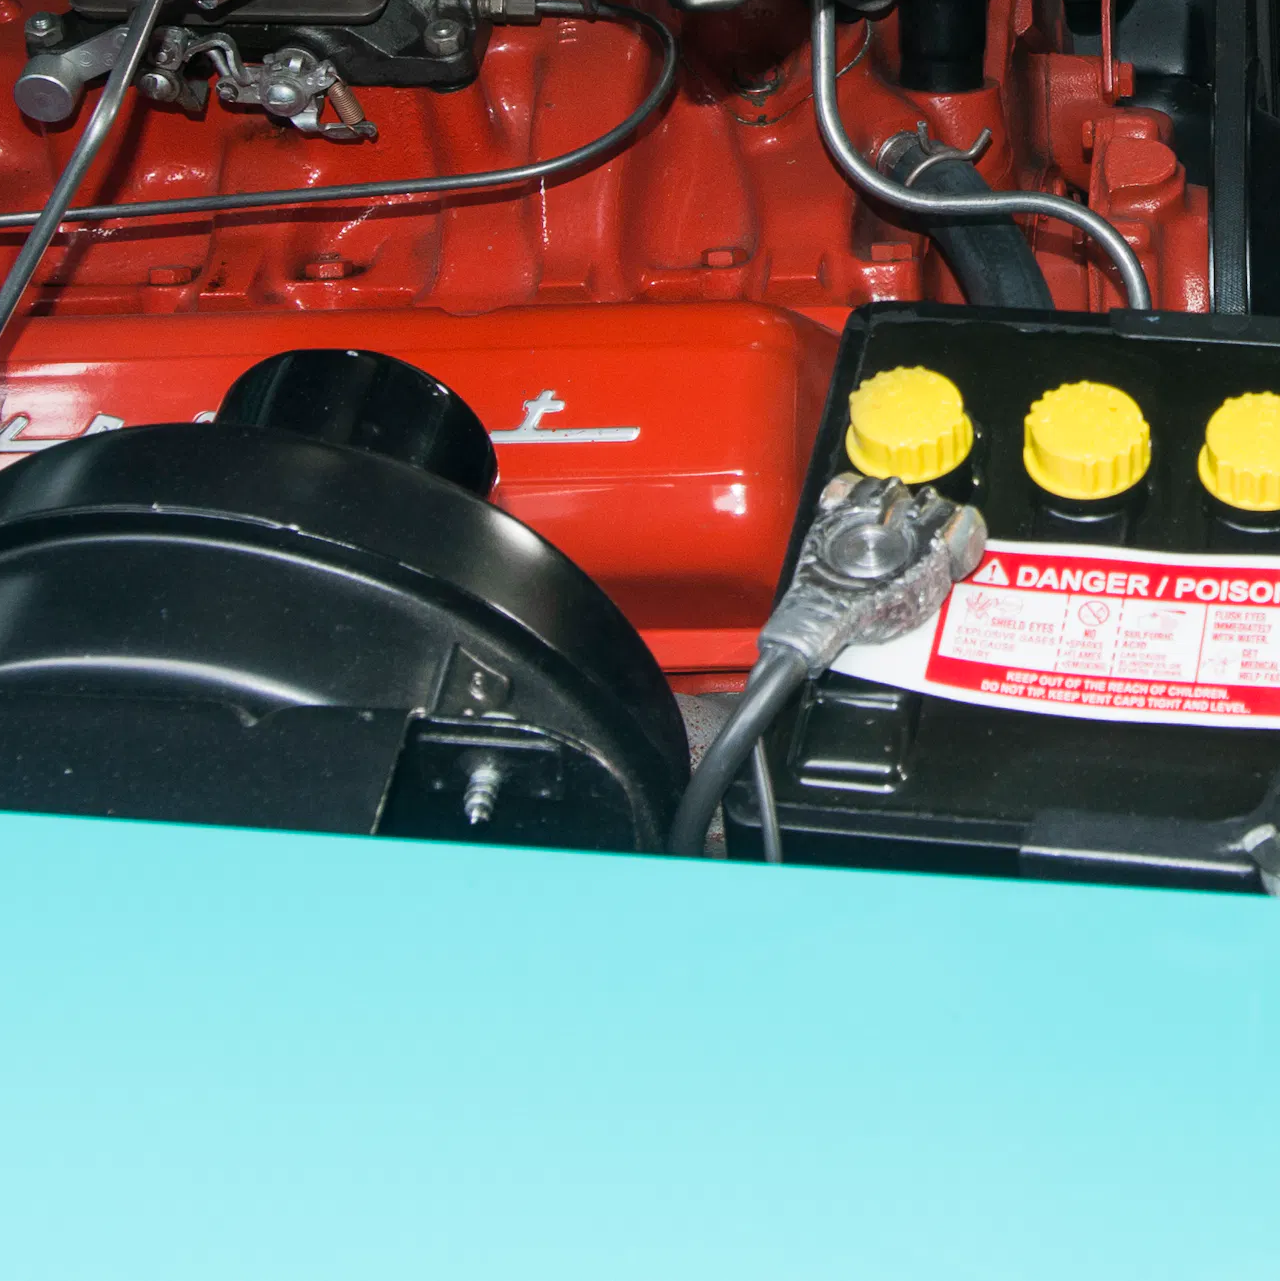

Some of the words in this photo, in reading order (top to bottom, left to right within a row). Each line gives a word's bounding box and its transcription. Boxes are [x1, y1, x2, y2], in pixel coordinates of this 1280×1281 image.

[1016, 566, 1149, 597] DANGER
[1155, 576, 1170, 598] /
[991, 617, 1026, 631] SHIELD
[1028, 621, 1055, 634] EYES
[980, 679, 1000, 693] DO
[1000, 683, 1026, 697] NOT
[1026, 686, 1046, 699] TIP.
[1047, 688, 1080, 702] KEEP
[1081, 691, 1113, 705] VENT
[1112, 694, 1146, 708] CAPS
[1147, 697, 1182, 710] TIGHT
[1182, 699, 1209, 712] AND
[1209, 701, 1252, 714] LEVEL.
[1006, 671, 1039, 685] KEEP
[1039, 675, 1065, 688] OUT
[1065, 678, 1082, 689] OF
[1084, 679, 1107, 692] THE
[1107, 681, 1149, 695] REACH
[1149, 683, 1167, 696] OF
[1167, 685, 1230, 700] CHILDREN.
